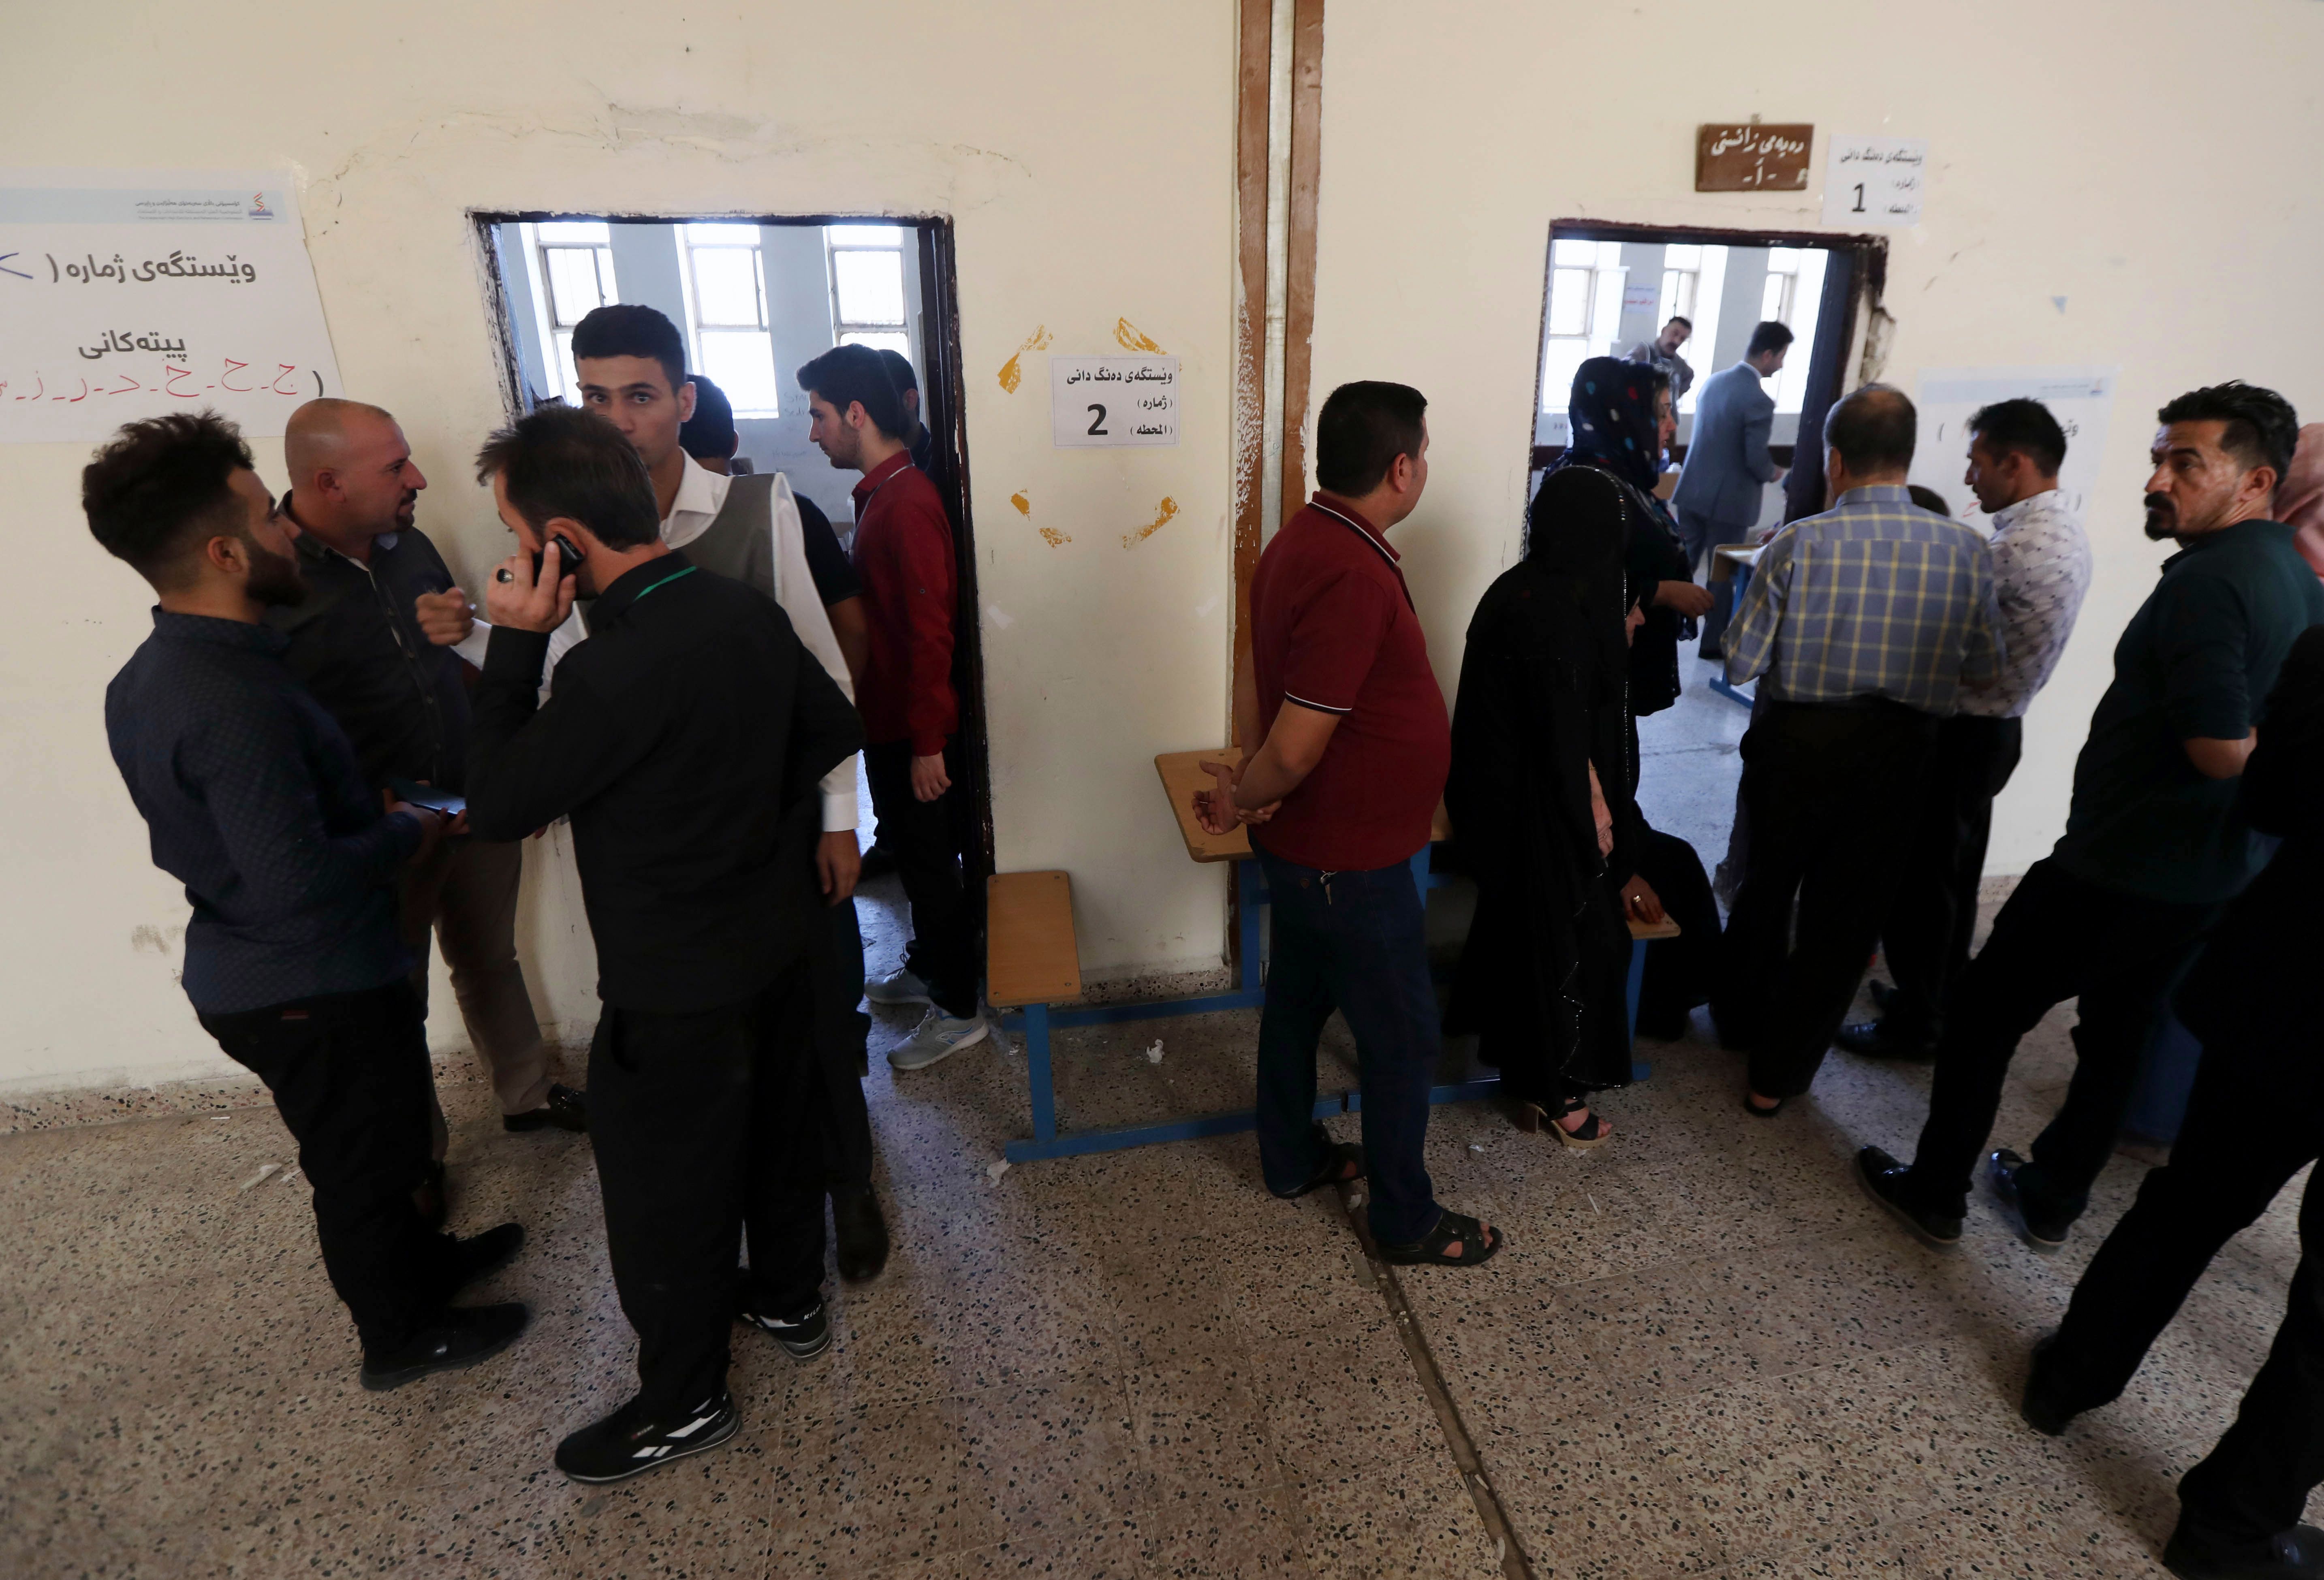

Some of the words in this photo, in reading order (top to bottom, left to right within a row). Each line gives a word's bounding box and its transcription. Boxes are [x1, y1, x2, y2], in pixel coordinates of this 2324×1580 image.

[1852, 182, 1866, 212] 1
[66, 254, 126, 283] ژمارە
[132, 250, 256, 284] وێستگەی
[78, 330, 187, 362] پیتەکانی
[1067, 369, 1091, 384] دانی
[1094, 367, 1121, 381] دەنگ
[1125, 367, 1173, 384] وێستگەی
[1087, 404, 1108, 435] 2
